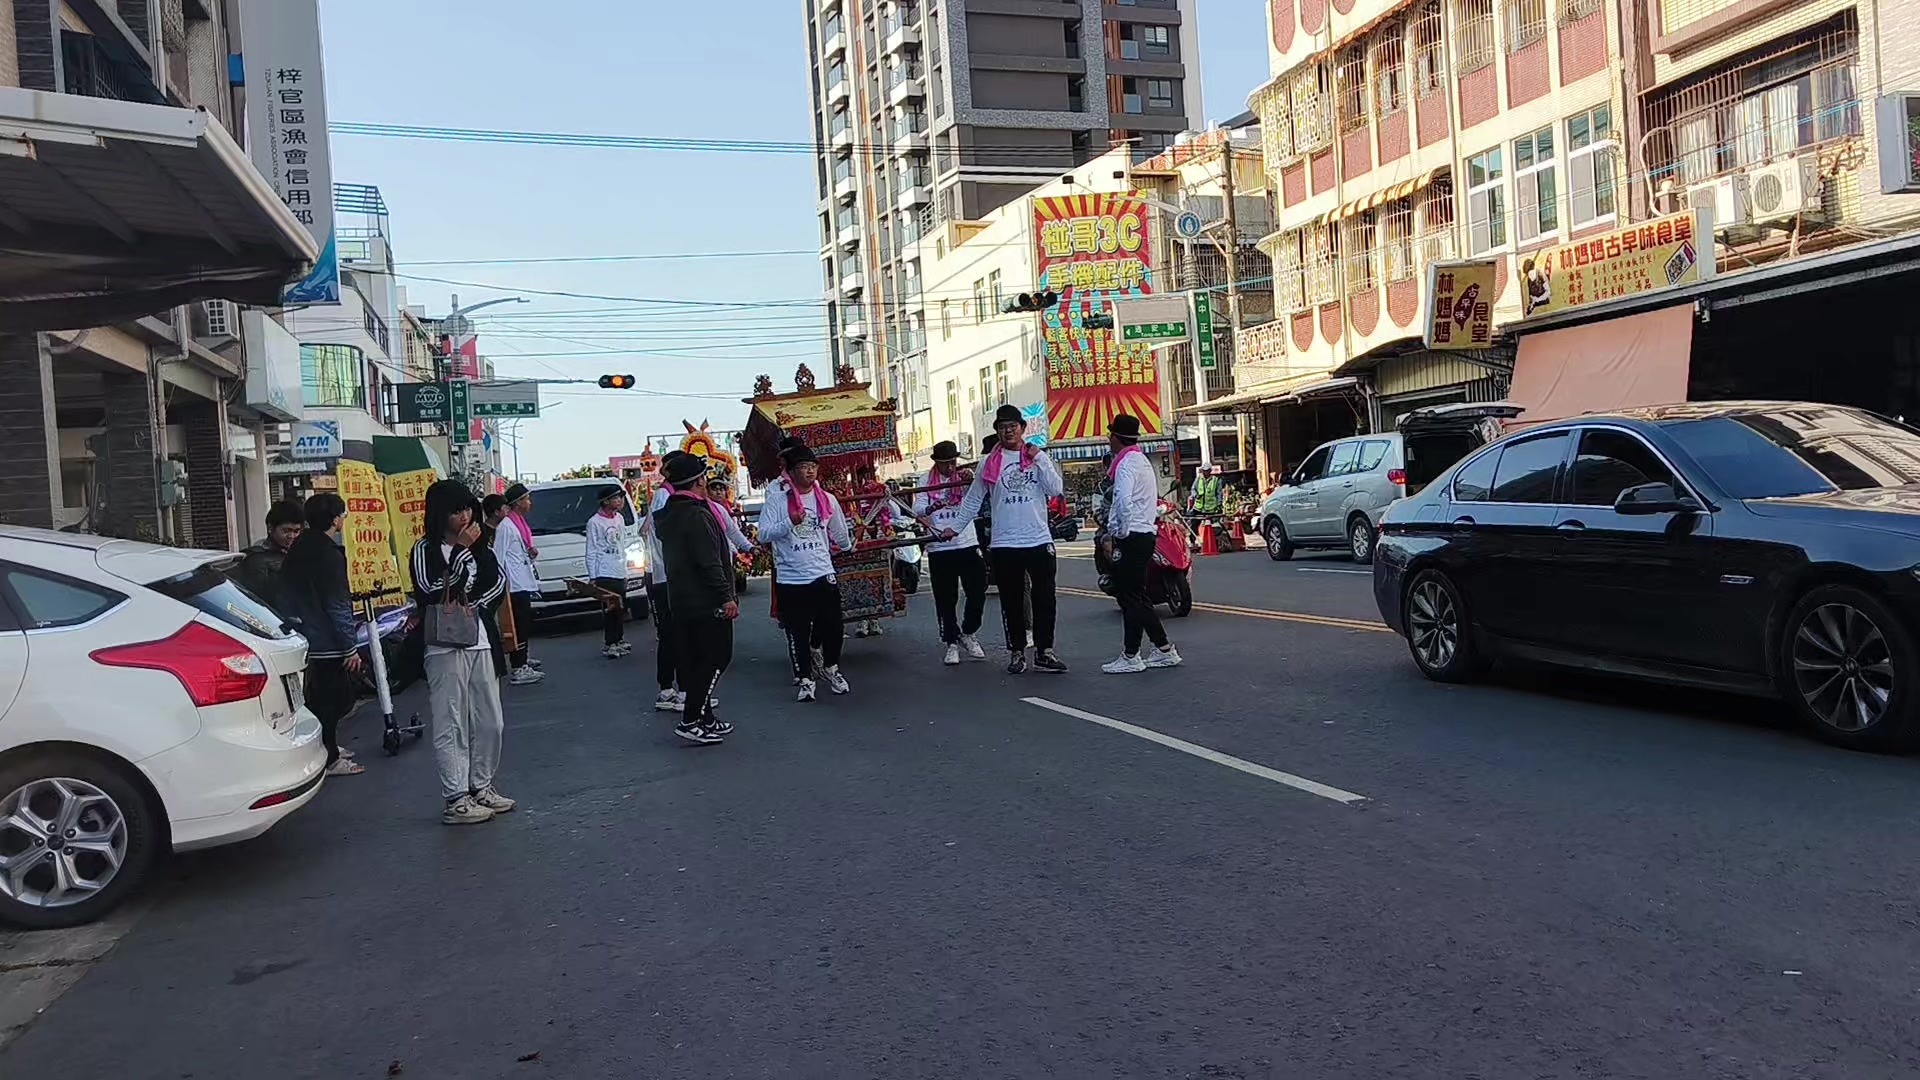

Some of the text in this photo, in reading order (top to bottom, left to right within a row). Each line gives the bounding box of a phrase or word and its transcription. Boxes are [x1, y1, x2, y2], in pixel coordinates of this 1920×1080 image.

[270, 135, 280, 178] ASSOCIATION
[277, 68, 314, 225] 梓官區漁會信用部
[1560, 216, 1692, 270] 林媽媽古早味食堂
[1046, 259, 1144, 293] 手機配件
[1434, 272, 1454, 343] 林媽媽
[1455, 286, 1477, 320] 古早味
[1472, 302, 1488, 342] 食堂
[1198, 305, 1211, 351] 中正路
[415, 393, 445, 404] MWD
[454, 391, 466, 430] 中正路
[296, 436, 329, 447] ATM
